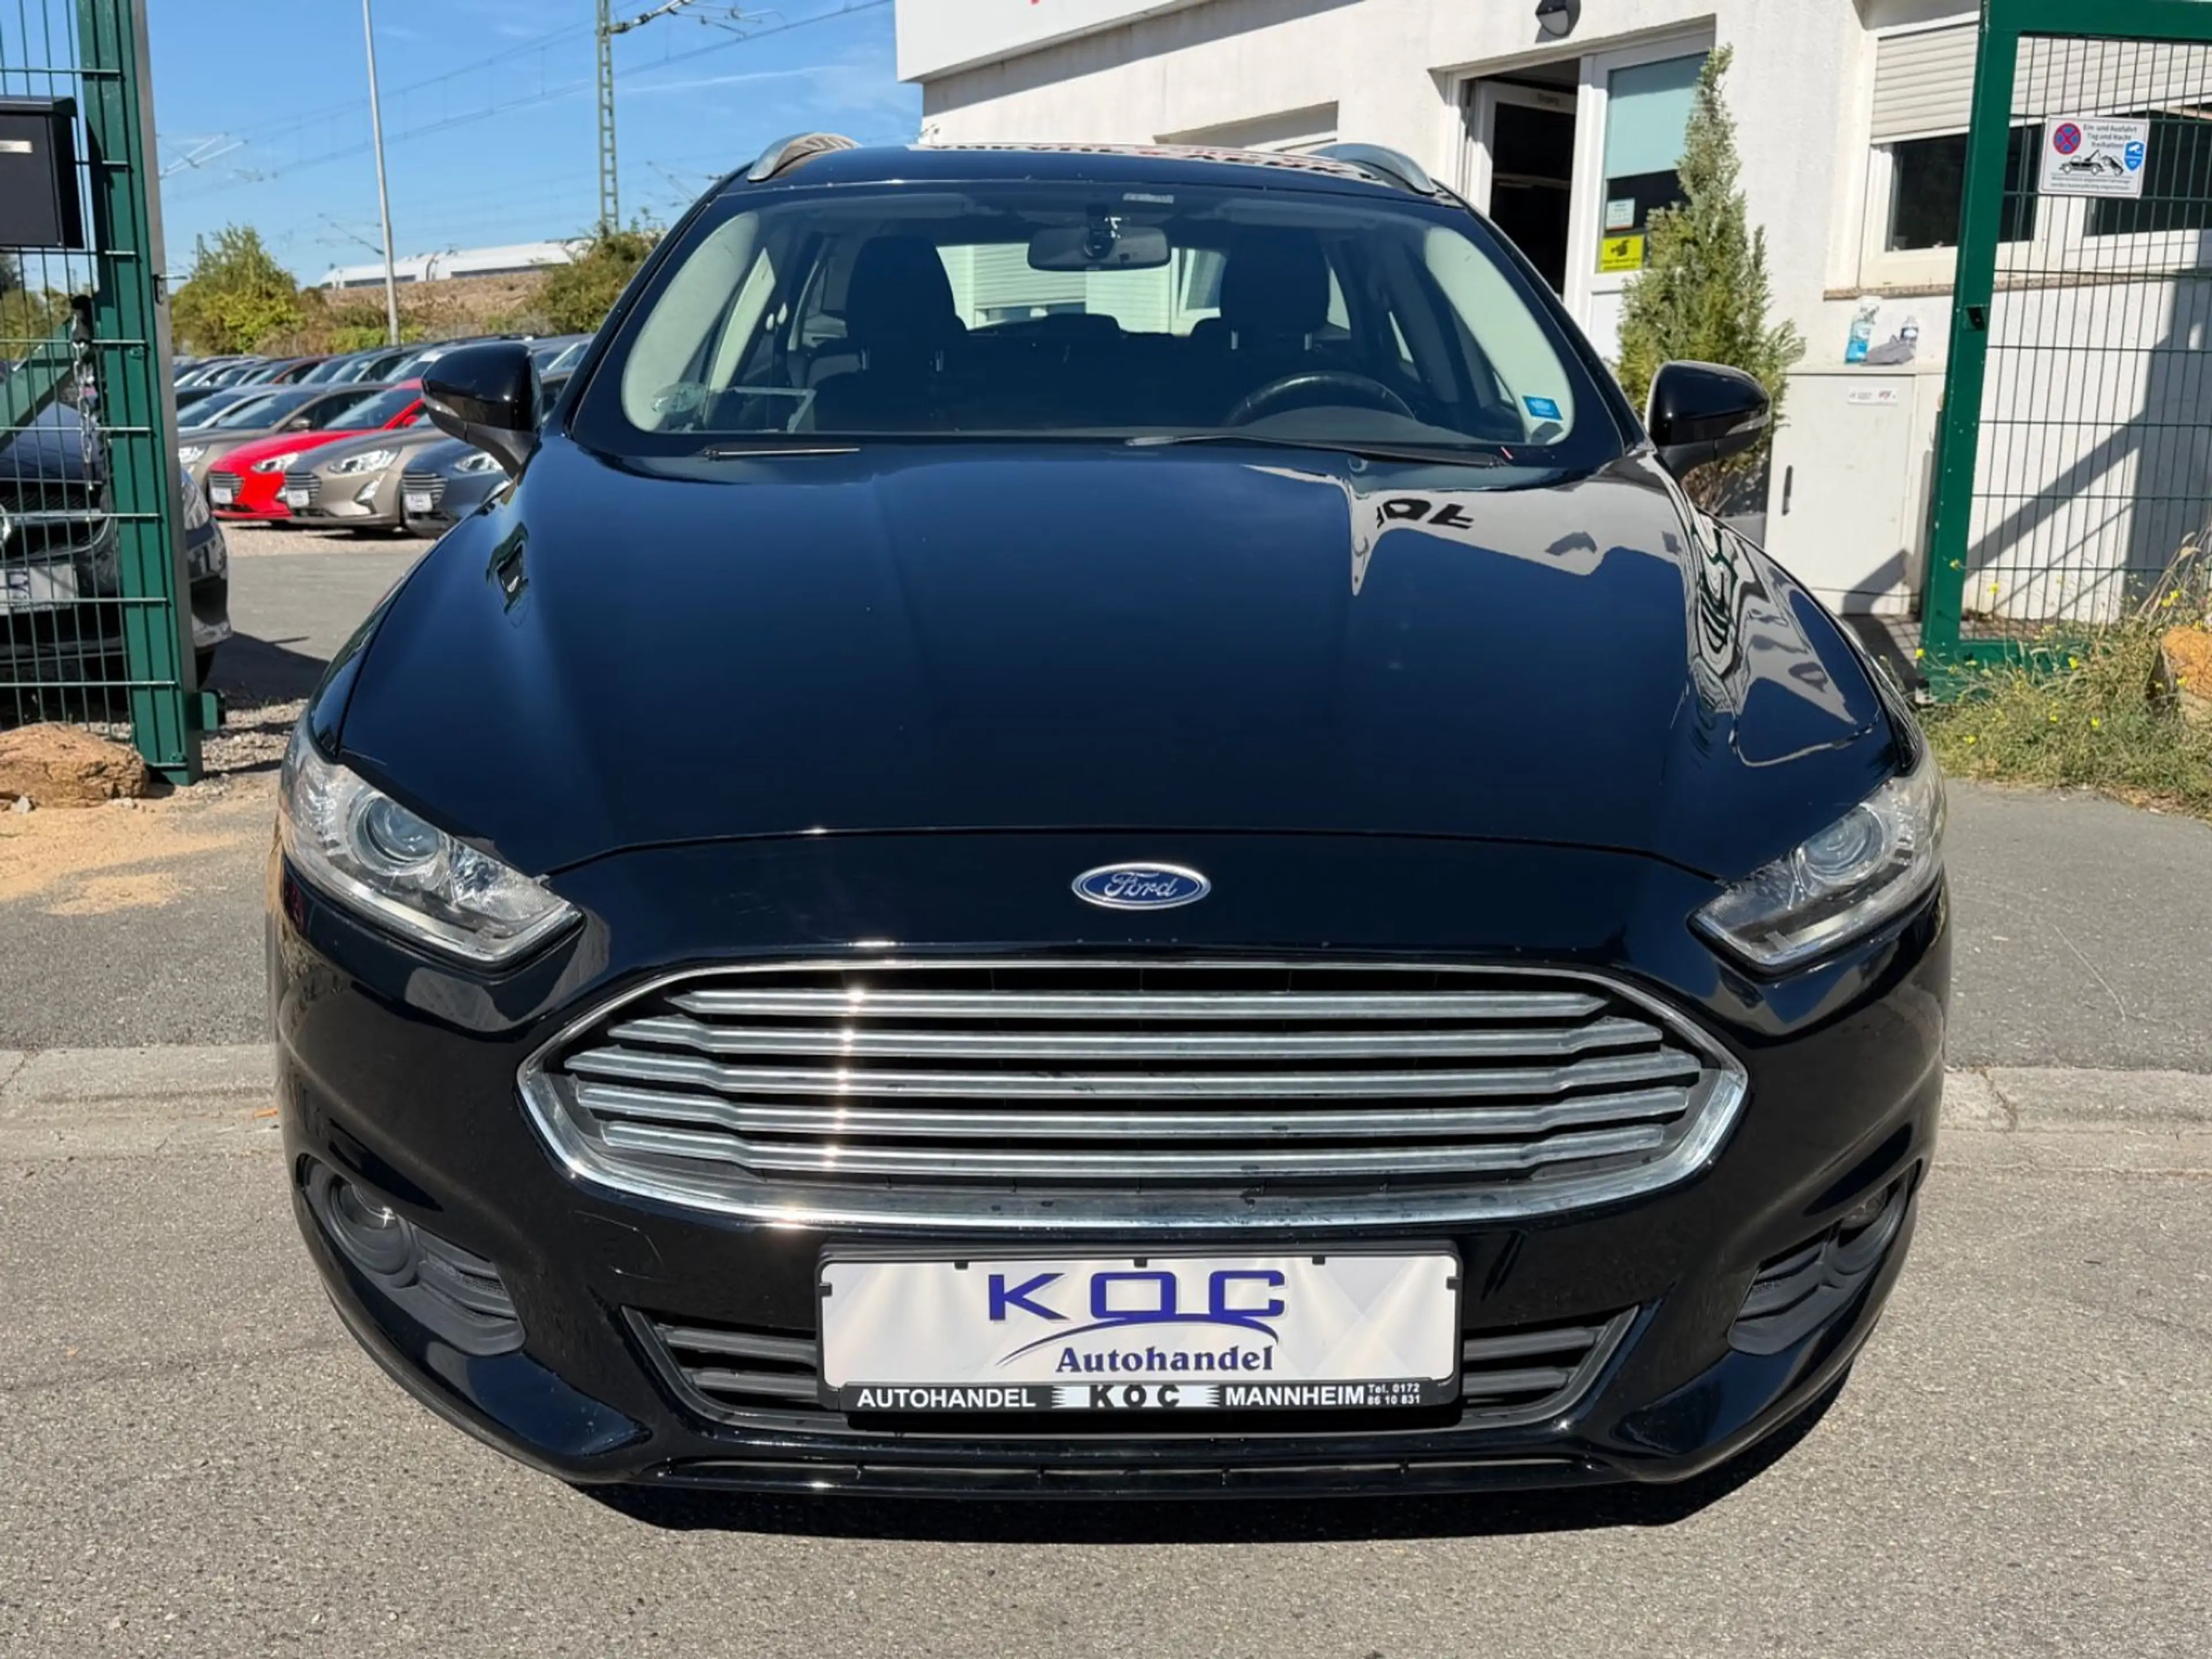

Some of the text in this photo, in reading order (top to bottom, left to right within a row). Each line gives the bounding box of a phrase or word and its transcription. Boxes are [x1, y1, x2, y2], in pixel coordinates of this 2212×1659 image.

[1104, 872, 1178, 897] Ford
[988, 1270, 1286, 1321] KOC
[1055, 1345, 1274, 1373] Autohandel
[857, 1388, 1036, 1408] AUTOHANDEL
[1225, 1385, 1365, 1406] MANNHEIM
[1368, 1382, 1421, 1393] Tel. 0172
